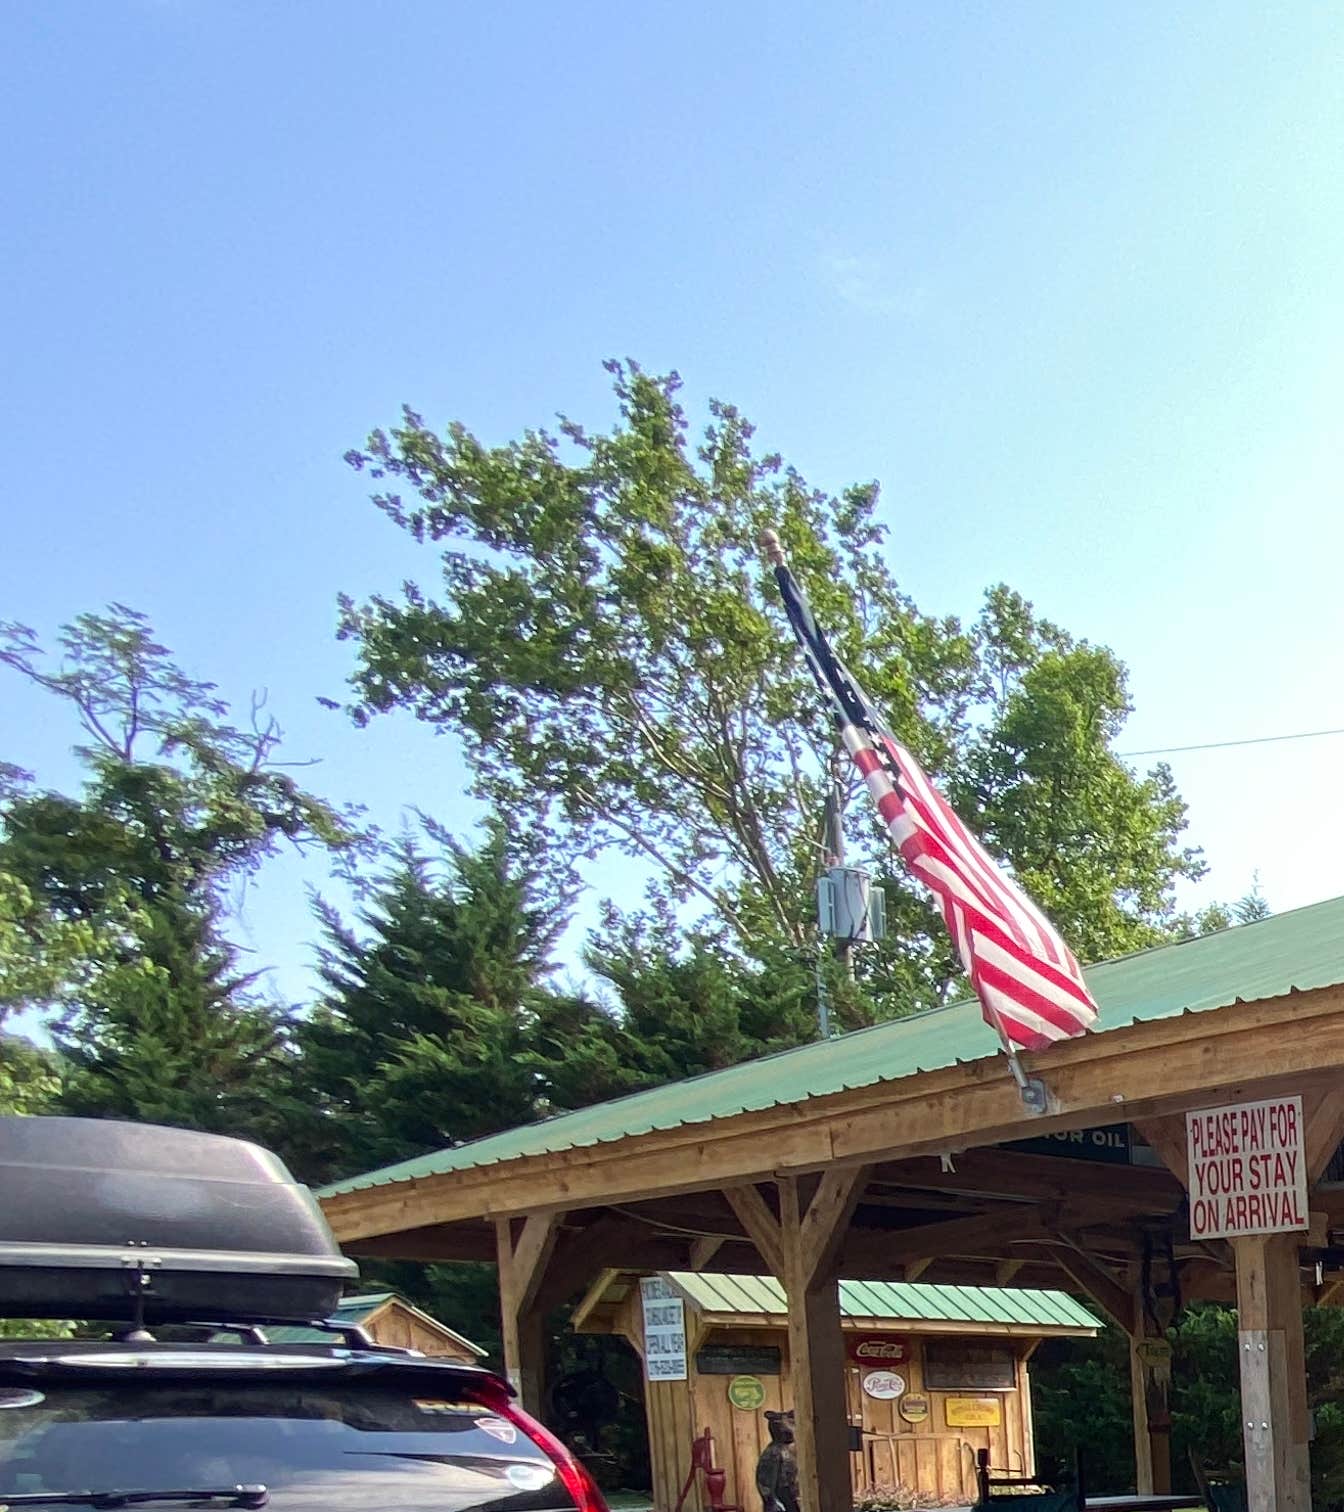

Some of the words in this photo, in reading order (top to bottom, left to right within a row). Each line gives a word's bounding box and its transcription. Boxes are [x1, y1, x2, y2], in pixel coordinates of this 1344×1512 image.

[1091, 1130, 1126, 1148] OIL
[1191, 1112, 1239, 1160] PLEASE
[1241, 1107, 1266, 1152] PAY
[1269, 1103, 1298, 1149] FOR
[1195, 1157, 1244, 1197] YOUR
[1249, 1150, 1298, 1190] STAY
[1193, 1199, 1220, 1234] ON
[1225, 1190, 1305, 1231] ARRIVAL
